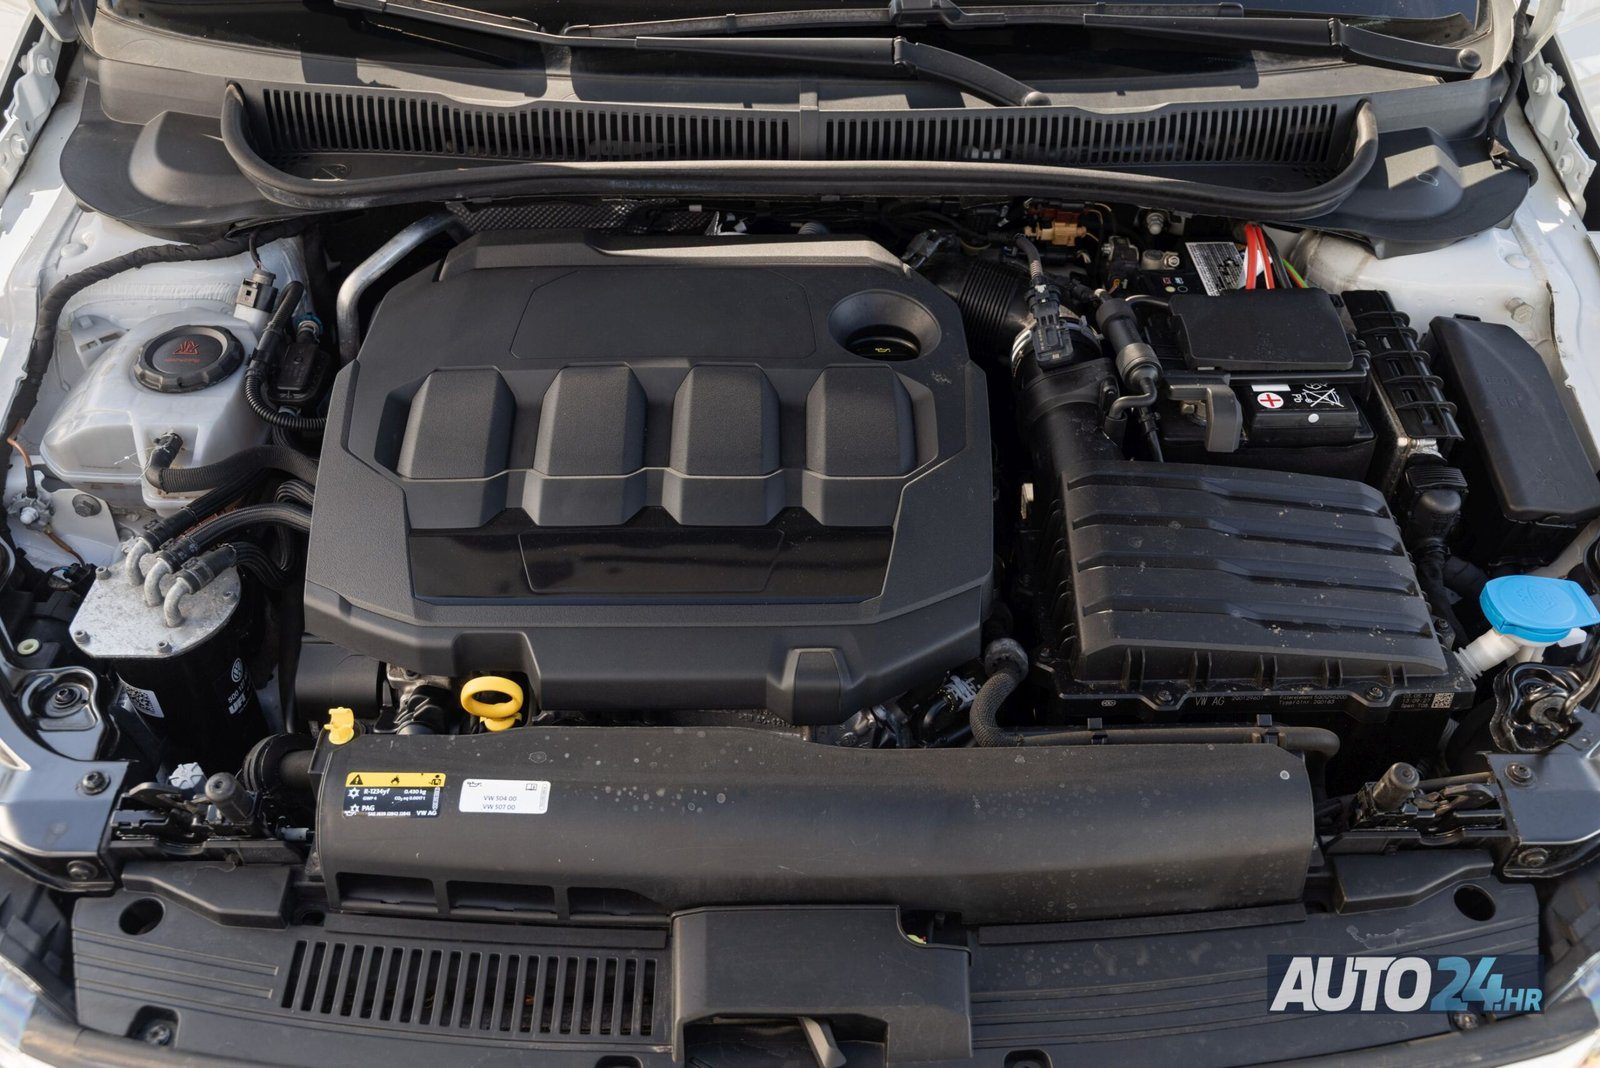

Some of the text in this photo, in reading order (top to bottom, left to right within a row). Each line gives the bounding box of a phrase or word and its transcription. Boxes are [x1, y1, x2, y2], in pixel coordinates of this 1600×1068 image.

[1195, 696, 1208, 706] VW
[1212, 696, 1225, 706] AG
[363, 788, 390, 796] R-1234yf
